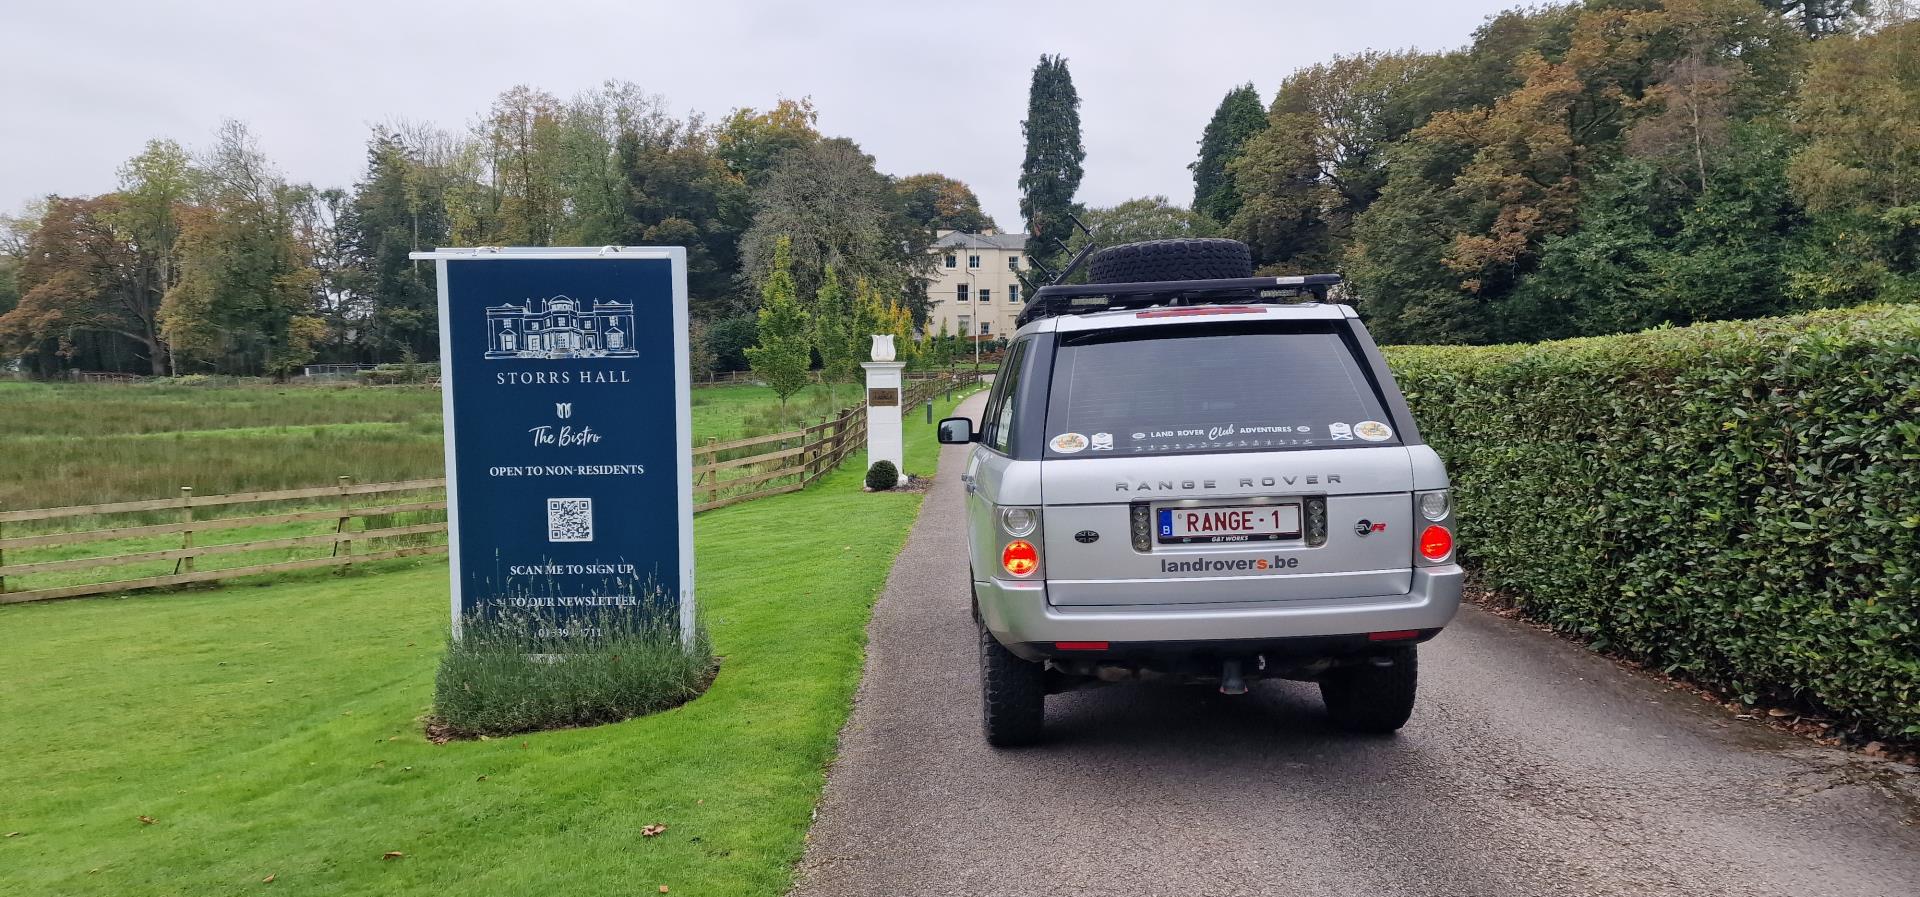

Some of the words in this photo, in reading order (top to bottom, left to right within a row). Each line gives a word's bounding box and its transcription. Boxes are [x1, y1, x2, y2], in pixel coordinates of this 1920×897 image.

[497, 371, 570, 384] STORRS
[580, 370, 630, 383] HALL
[528, 425, 555, 447] The
[558, 425, 601, 447] Bistro
[1178, 429, 1204, 437] ROVER
[1209, 424, 1234, 440] Club
[1240, 426, 1292, 434] ADVENTURES
[489, 466, 523, 476] OPEN
[525, 466, 543, 476] TO
[545, 464, 644, 476] NON-RESIDENTS
[1115, 480, 1217, 491] RANGE
[1239, 474, 1343, 488] ROVER
[1163, 526, 1170, 534] B
[1187, 511, 1254, 532] RANGE
[1271, 510, 1279, 529] 1
[510, 565, 543, 575] SCAN
[545, 565, 564, 575] ME
[566, 565, 583, 575] TO
[586, 564, 615, 574] SIGN
[618, 564, 634, 574] UP
[1161, 556, 1299, 573] landrovers.be
[557, 596, 637, 607] NEWSLETTER
